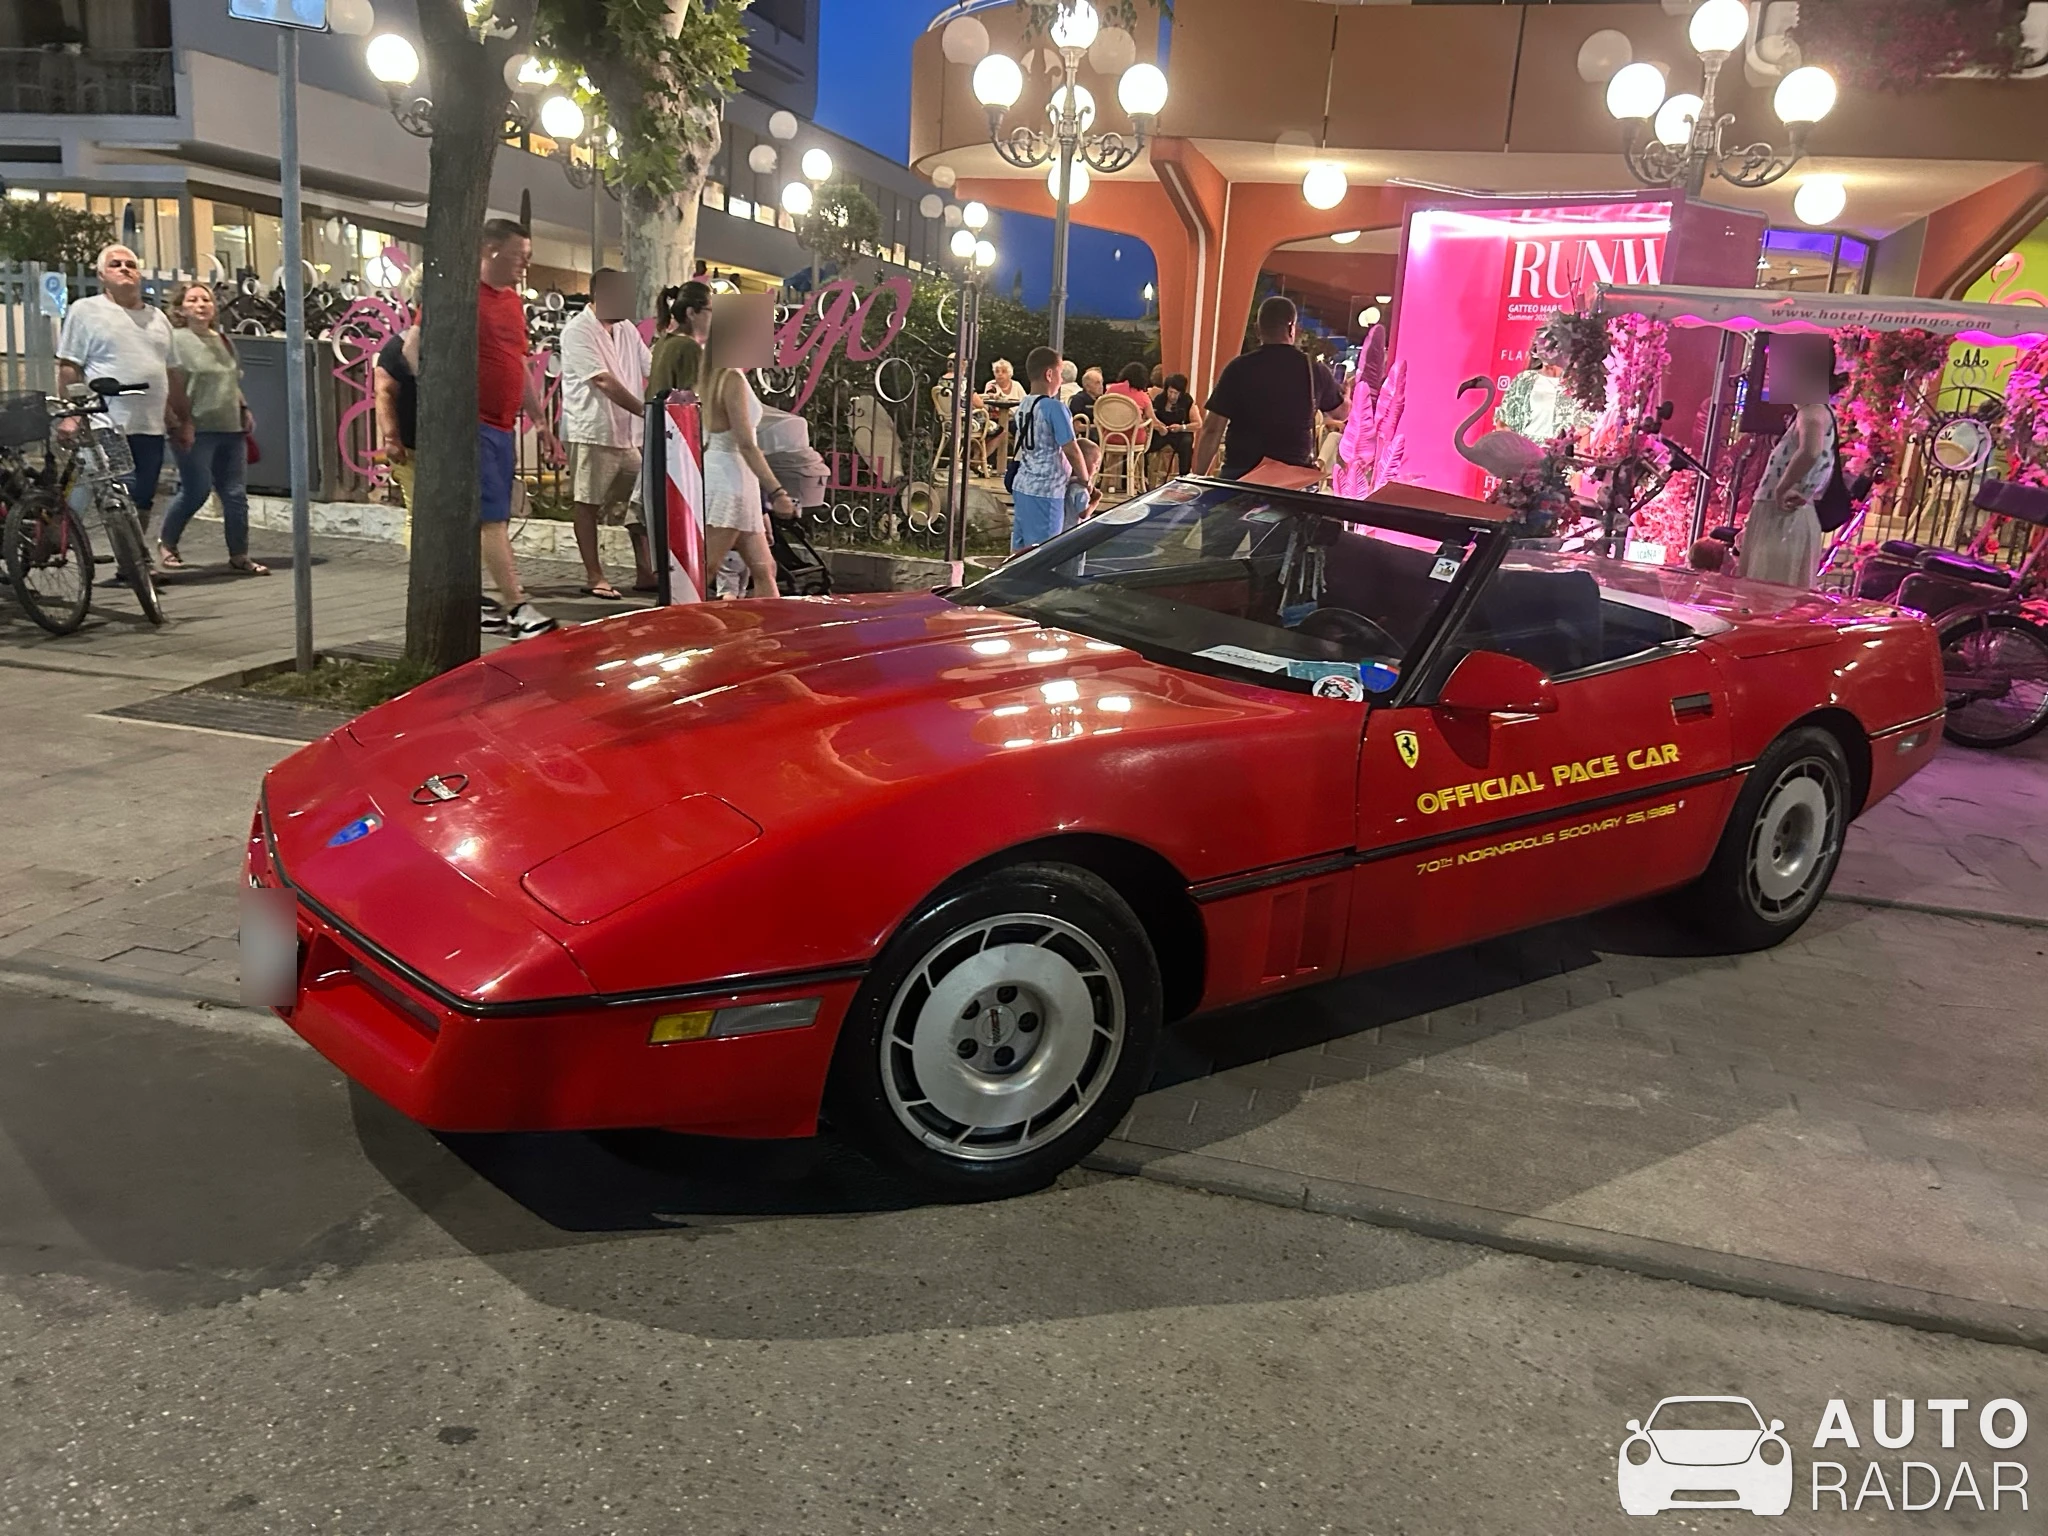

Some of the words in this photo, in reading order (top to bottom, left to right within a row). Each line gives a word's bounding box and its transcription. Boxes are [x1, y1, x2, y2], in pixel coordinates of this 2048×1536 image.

[1507, 313, 1534, 322] Summer
[1508, 303, 1539, 313] GATTEO
[1771, 306, 1992, 331] www.hotel-flamingo.com
[825, 451, 897, 495] TEL
[1416, 771, 1545, 815] OFFICIAL
[1551, 754, 1620, 787] PACE
[1626, 743, 1681, 771] CAR
[1416, 857, 1453, 876] 70TH
[1457, 832, 1555, 865] INDIANAPOLIS
